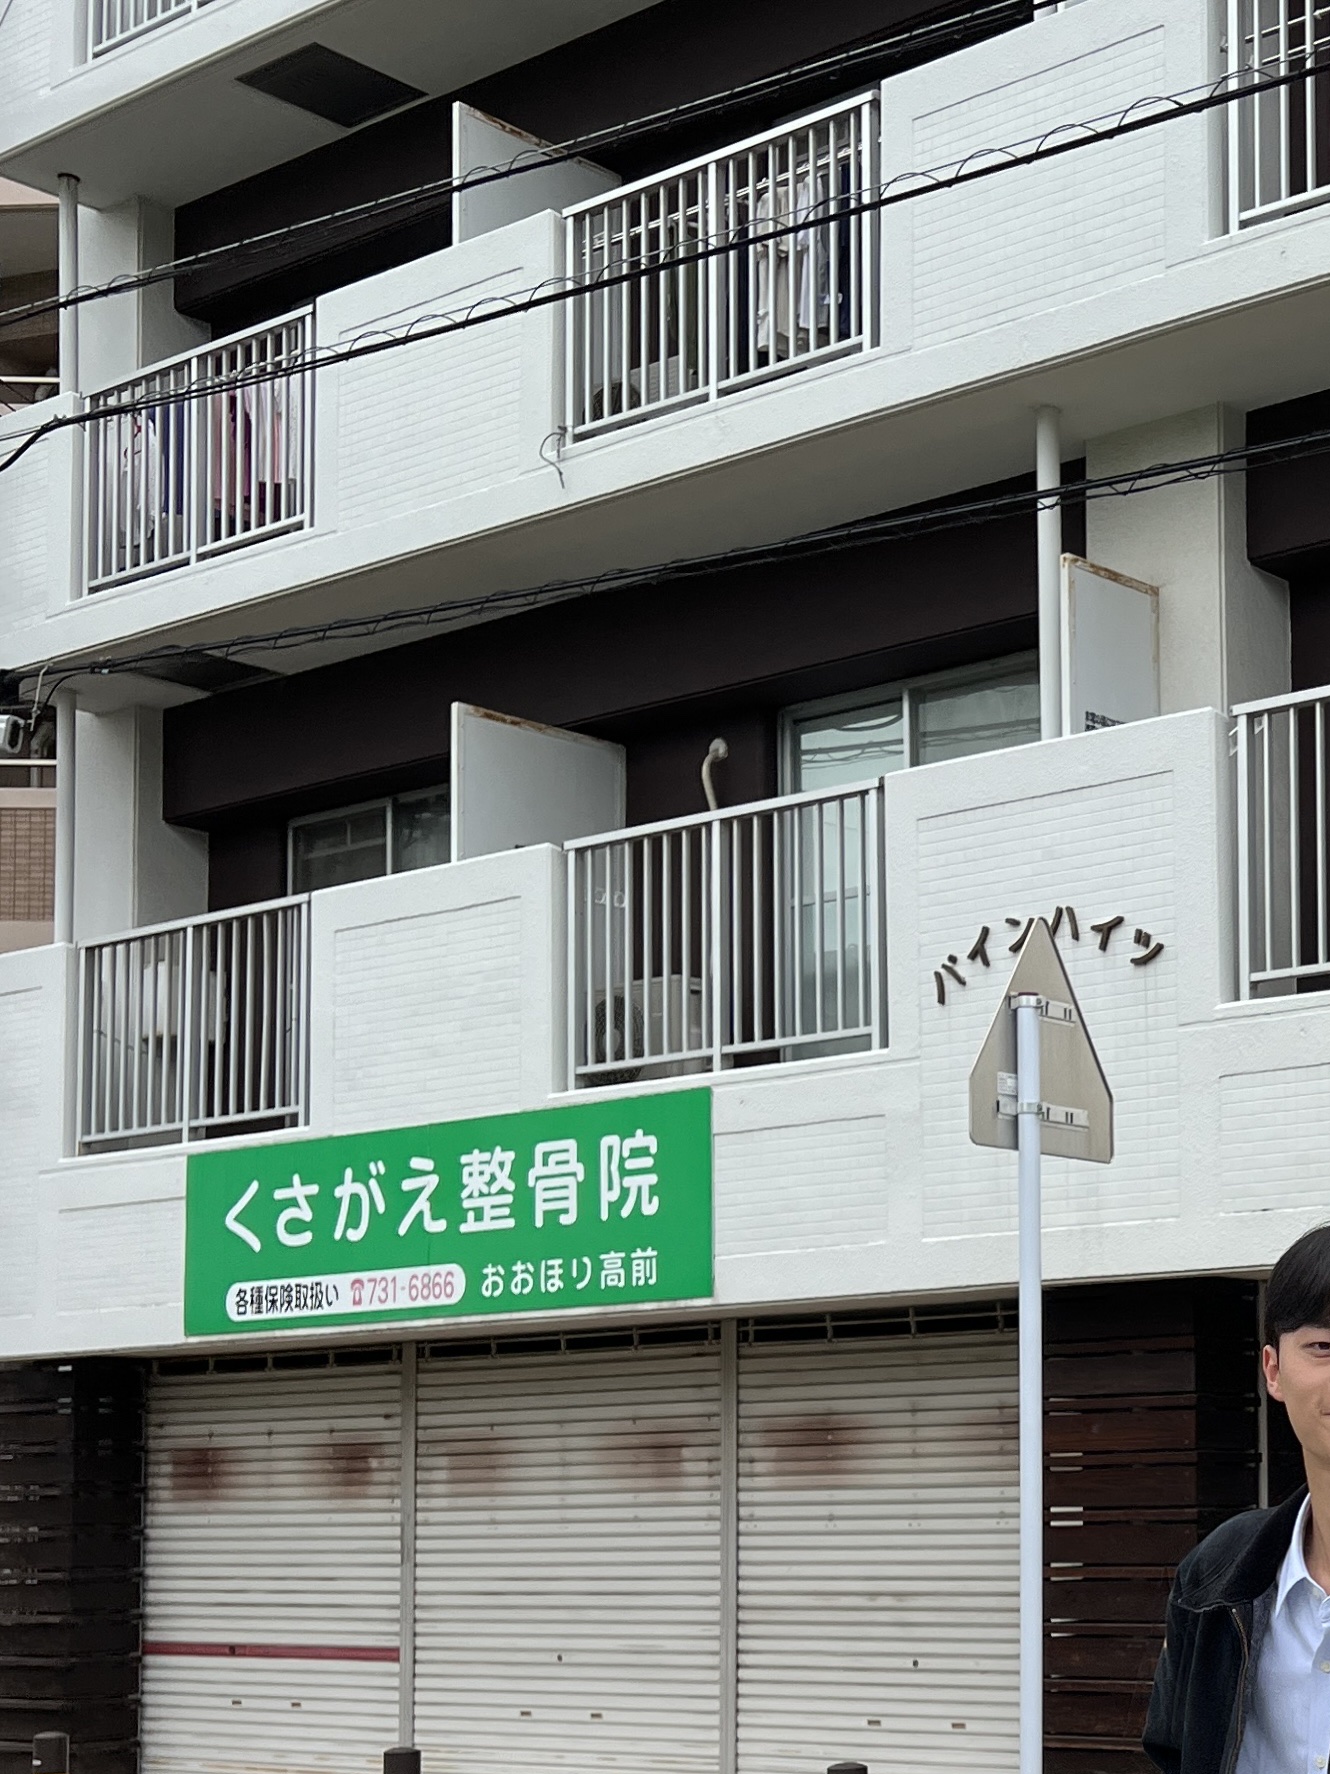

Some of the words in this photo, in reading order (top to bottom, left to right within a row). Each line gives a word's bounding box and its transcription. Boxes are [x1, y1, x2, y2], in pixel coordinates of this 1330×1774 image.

[224, 1128, 660, 1253] くさがえ整骨院
[235, 1281, 339, 1316] 各種保険取扱い
[480, 1246, 659, 1299] おおほり高前
